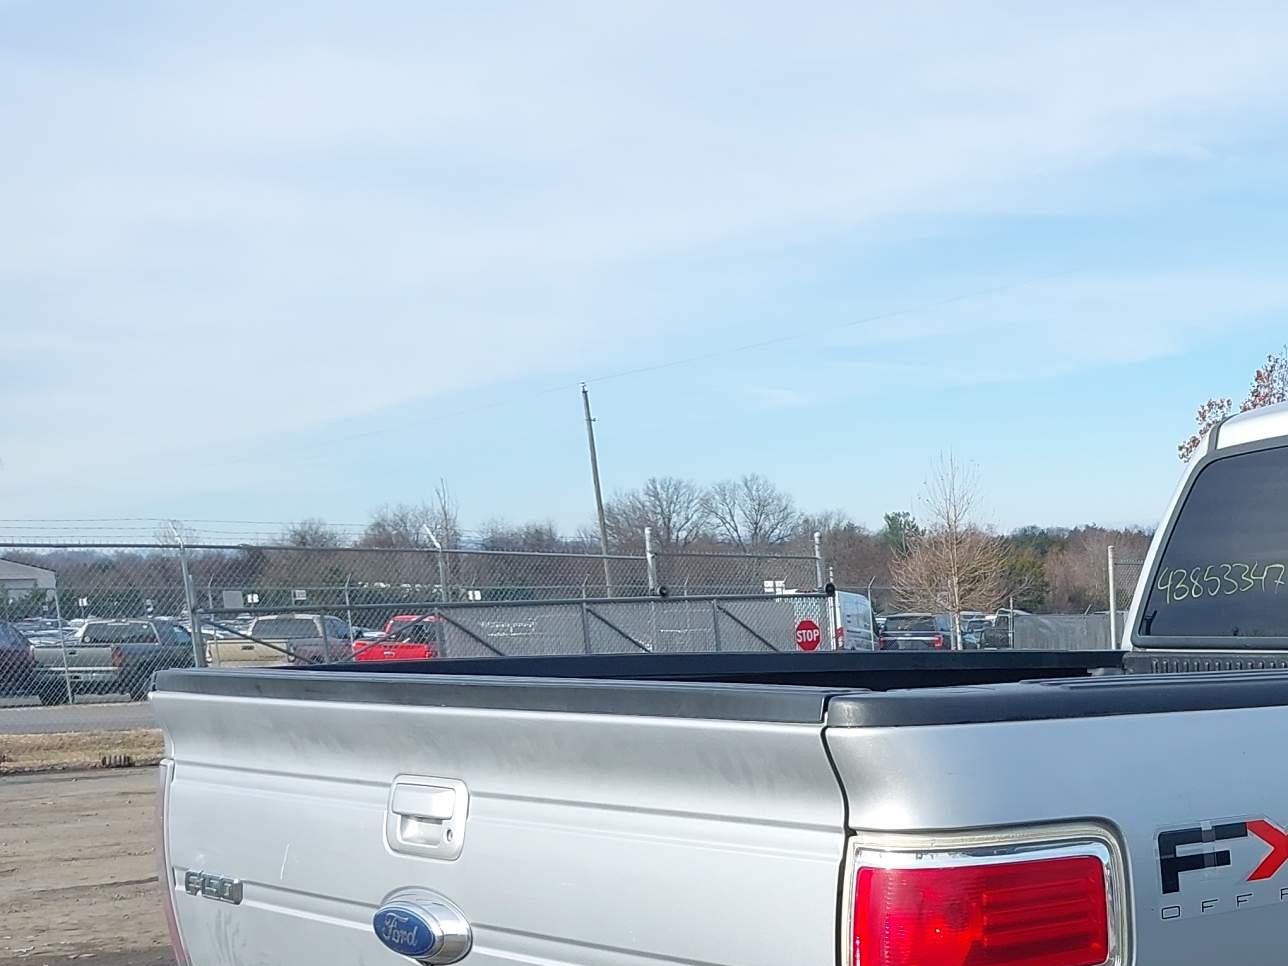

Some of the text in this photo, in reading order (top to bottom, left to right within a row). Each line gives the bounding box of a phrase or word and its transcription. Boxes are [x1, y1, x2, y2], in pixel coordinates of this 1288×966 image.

[1157, 561, 1285, 604] 43853347
[796, 629, 820, 642] STOP
[1161, 894, 1253, 920] OFF
[382, 911, 420, 948] Ford
